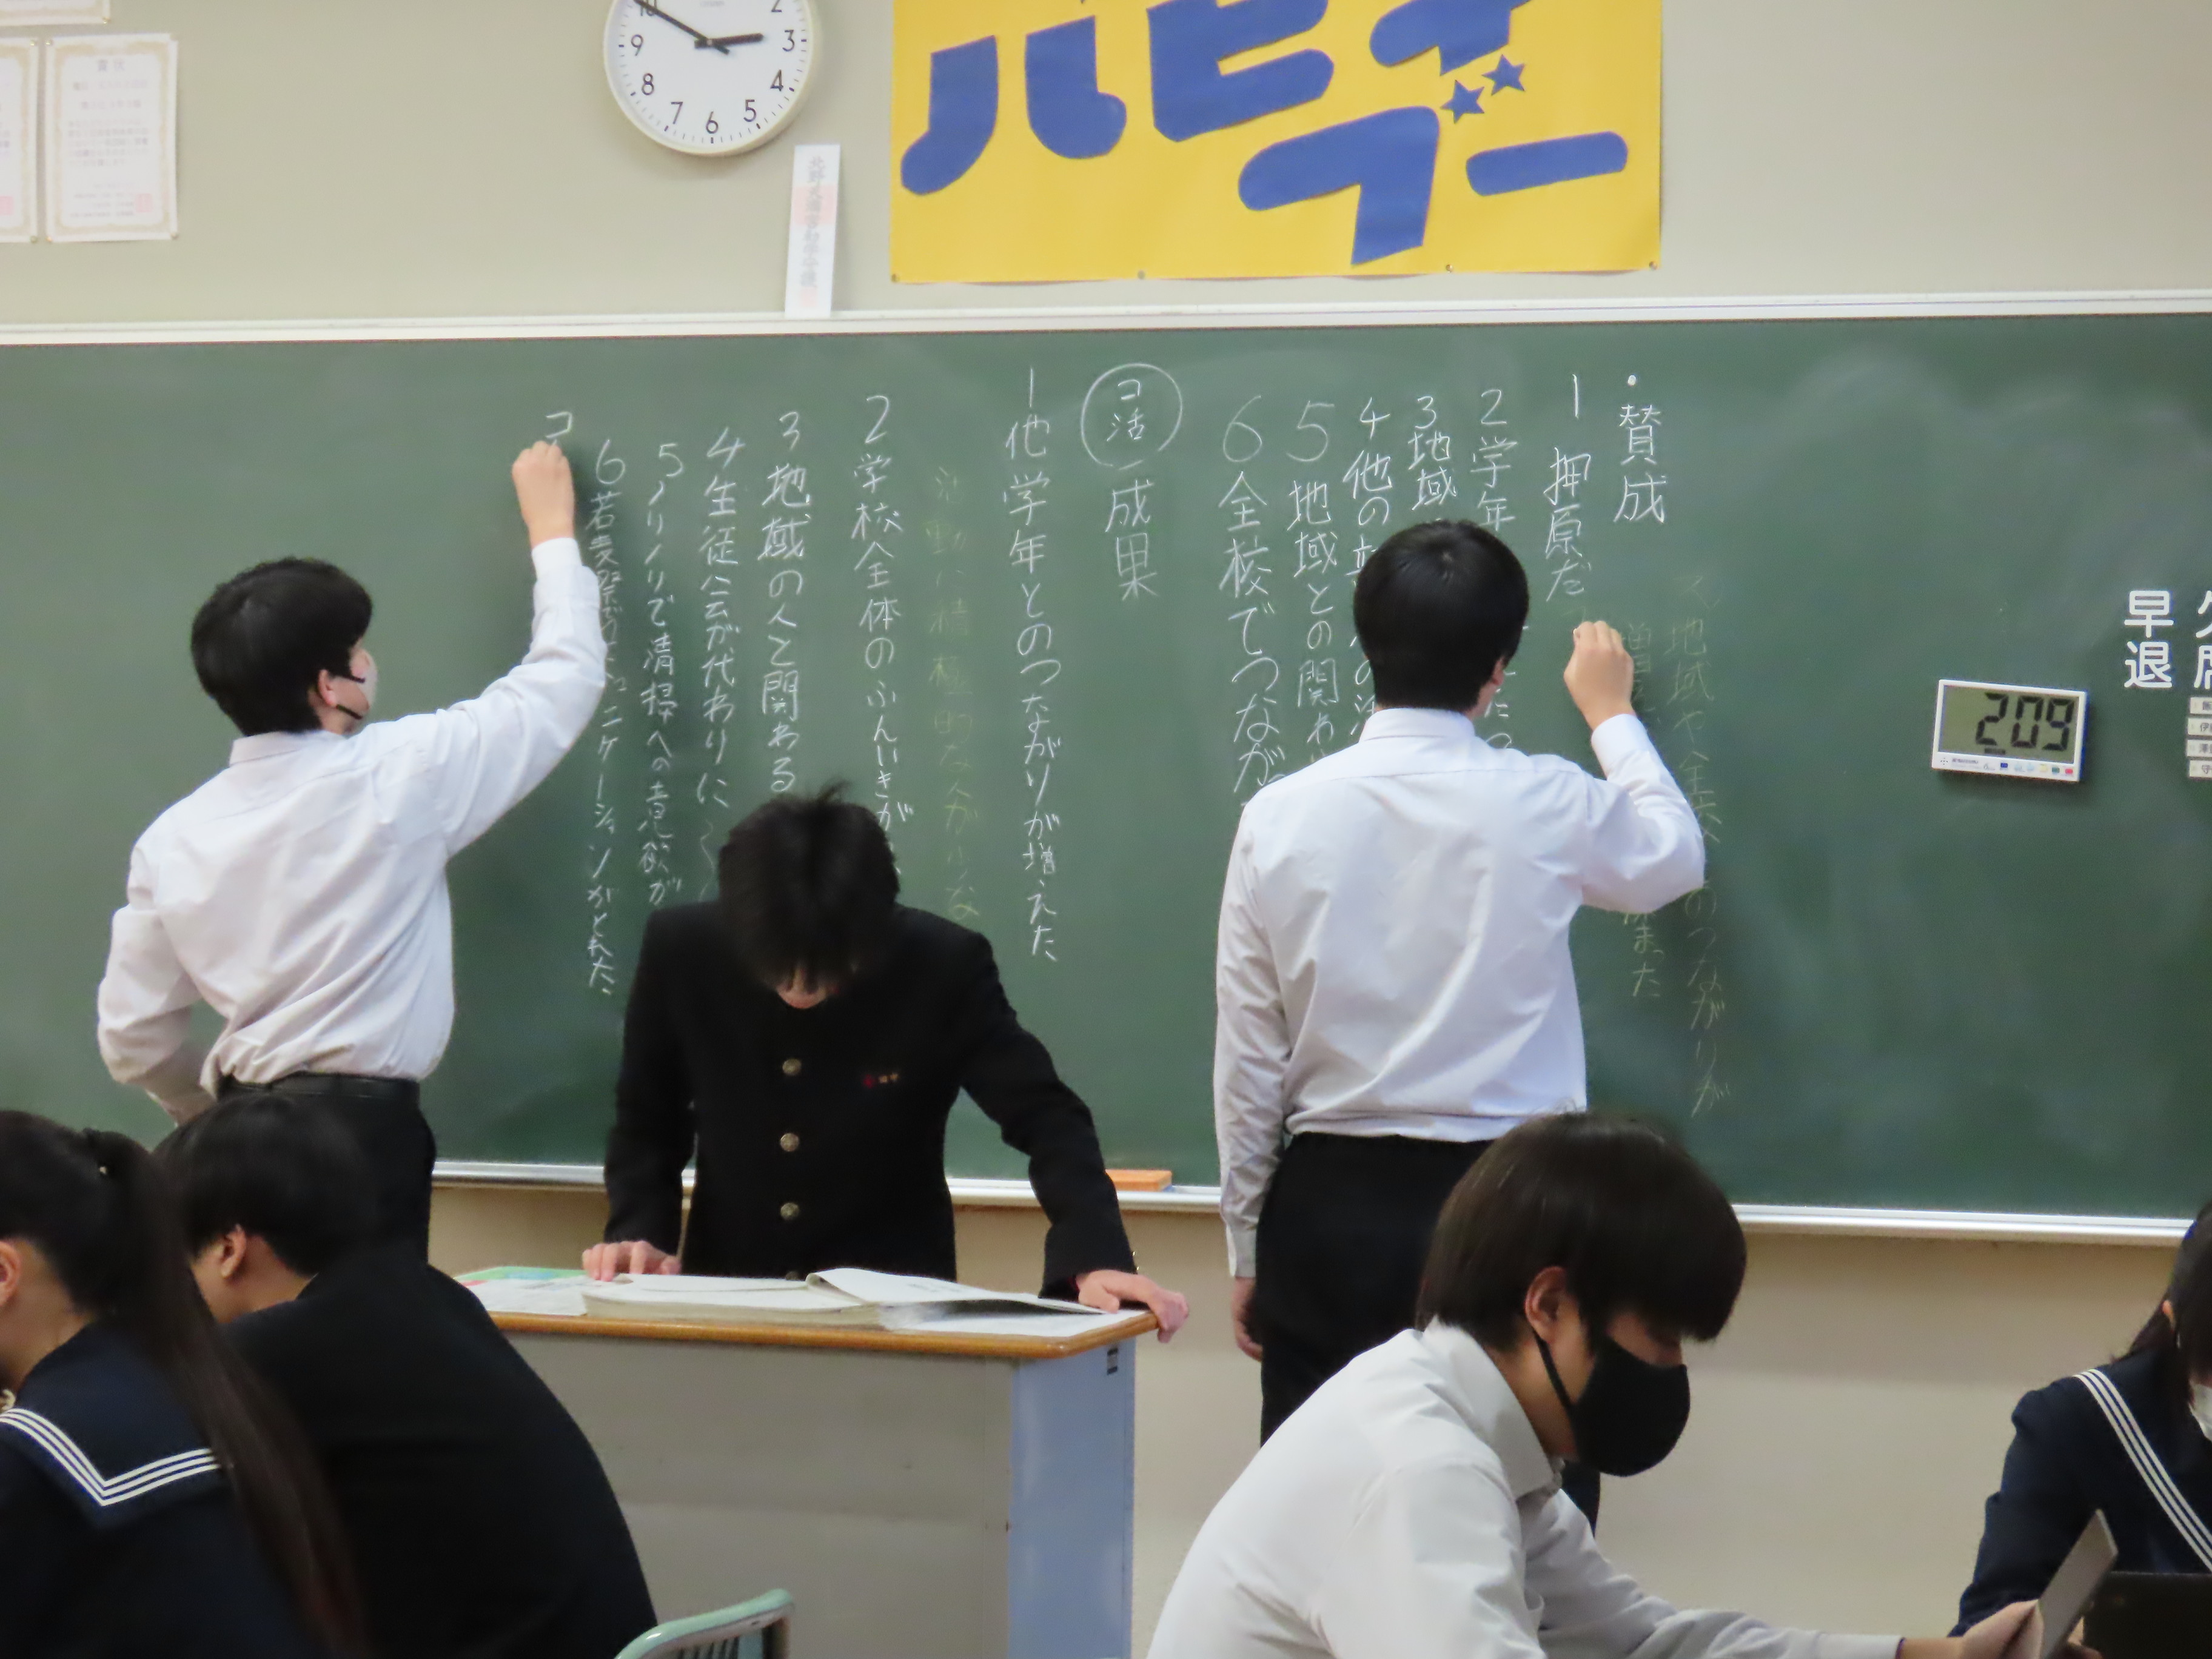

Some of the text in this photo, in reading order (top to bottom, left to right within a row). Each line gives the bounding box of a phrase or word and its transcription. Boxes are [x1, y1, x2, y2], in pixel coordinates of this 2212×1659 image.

[631, 34, 644, 56] 9
[782, 30, 796, 53] 3
[642, 73, 655, 96] 8
[770, 70, 783, 92] 4
[671, 101, 683, 125] 7
[743, 99, 757, 122] 5
[706, 112, 719, 134] 6
[1105, 480, 1159, 601] 成果
[851, 395, 914, 875] 2学校全体のふんいきが
[2123, 589, 2175, 689] 早退
